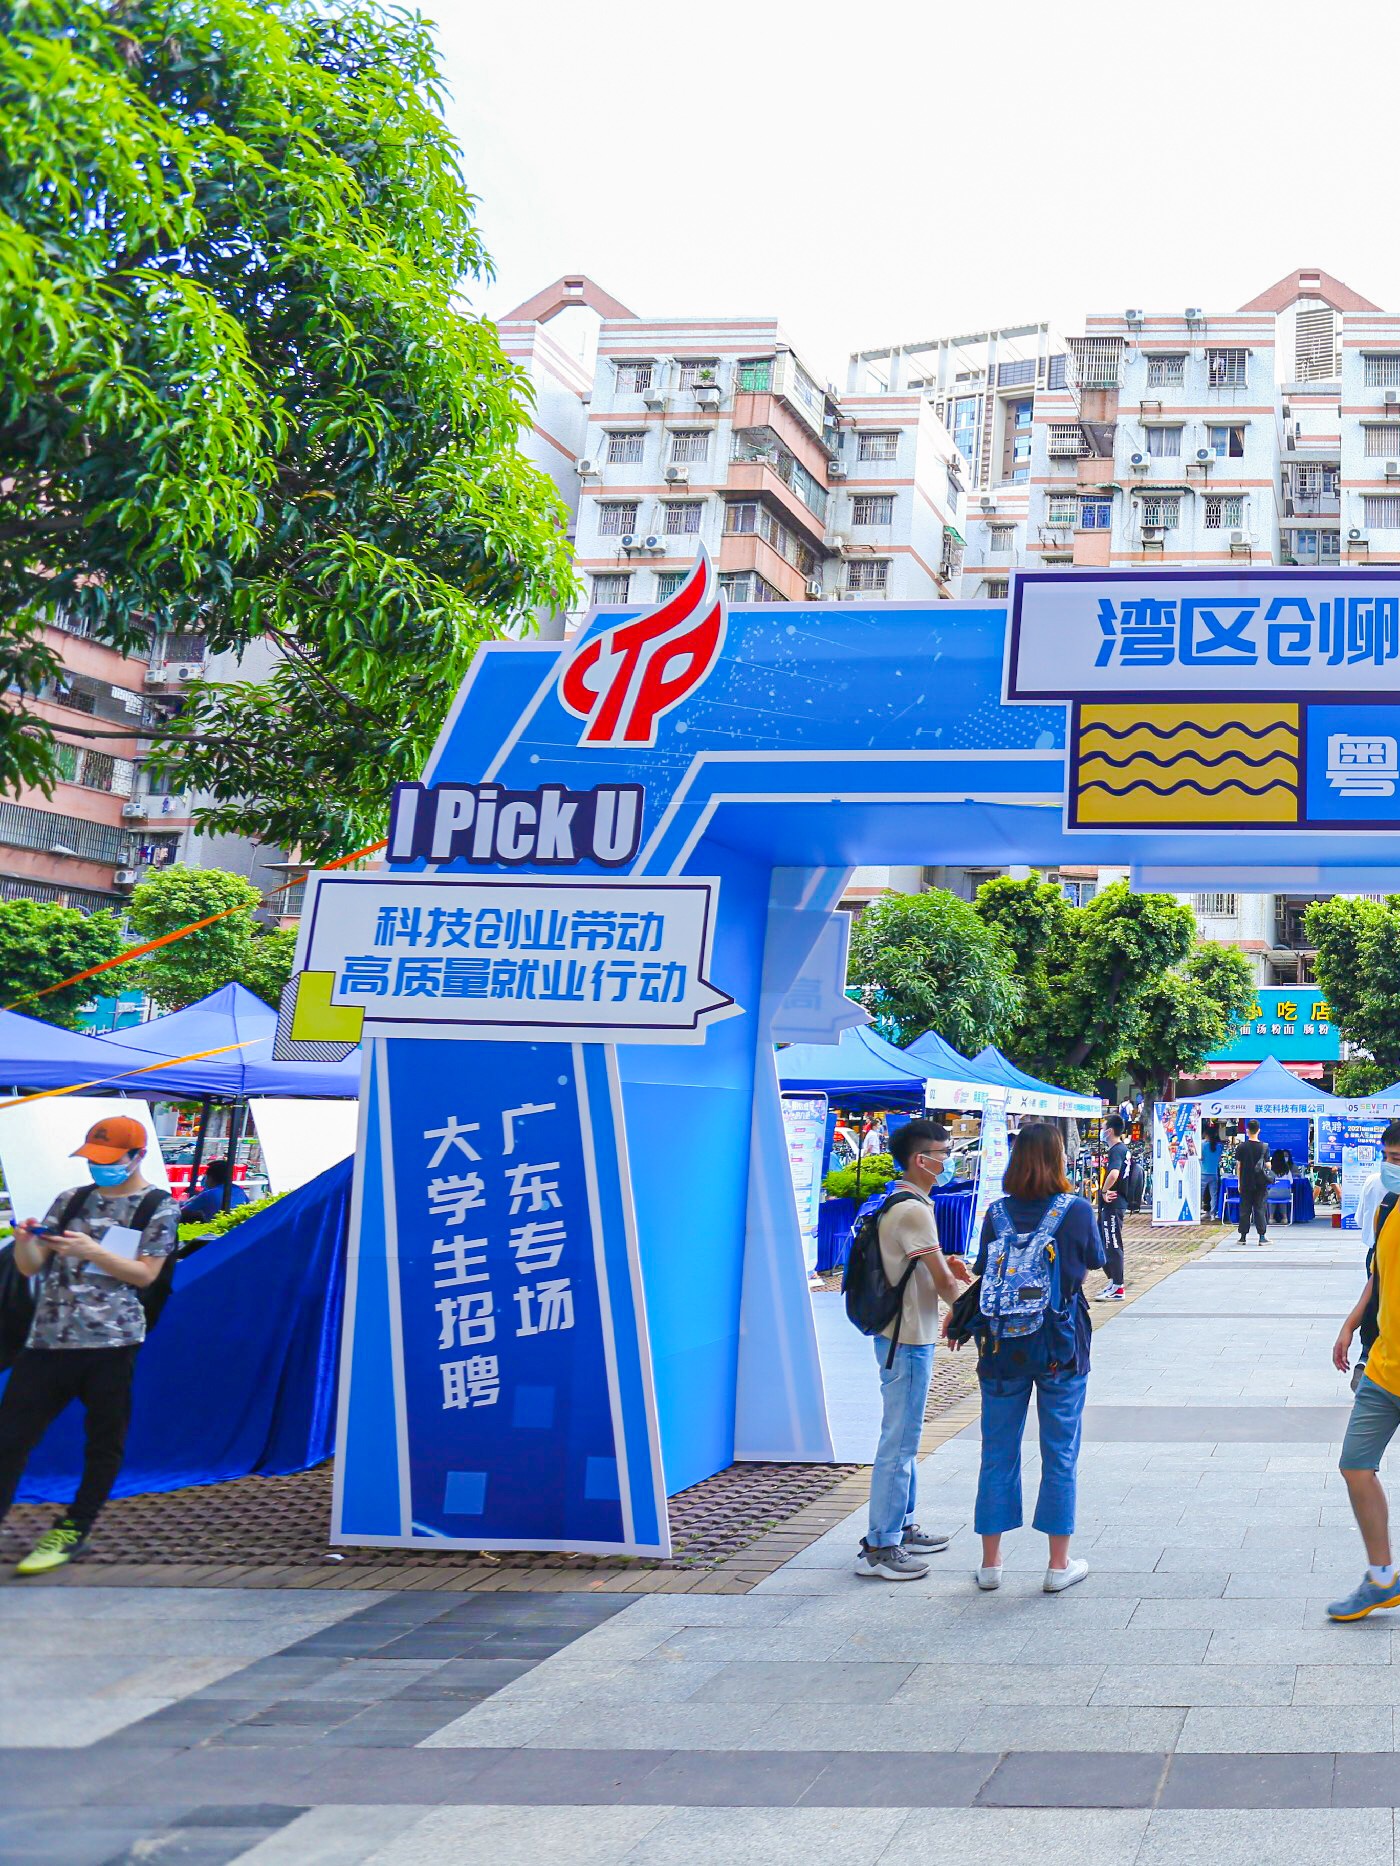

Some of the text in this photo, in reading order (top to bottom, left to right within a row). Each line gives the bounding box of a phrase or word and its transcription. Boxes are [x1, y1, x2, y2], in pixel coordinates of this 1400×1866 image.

[391, 788, 639, 861] I Pick U
[373, 905, 665, 952] 科技创业带动
[339, 954, 688, 1003] 高质量就业行动
[1254, 1103, 1325, 1113] 联奕科技有限公司
[501, 1101, 575, 1338] 广东专场
[423, 1115, 501, 1410] 大学生招聘
